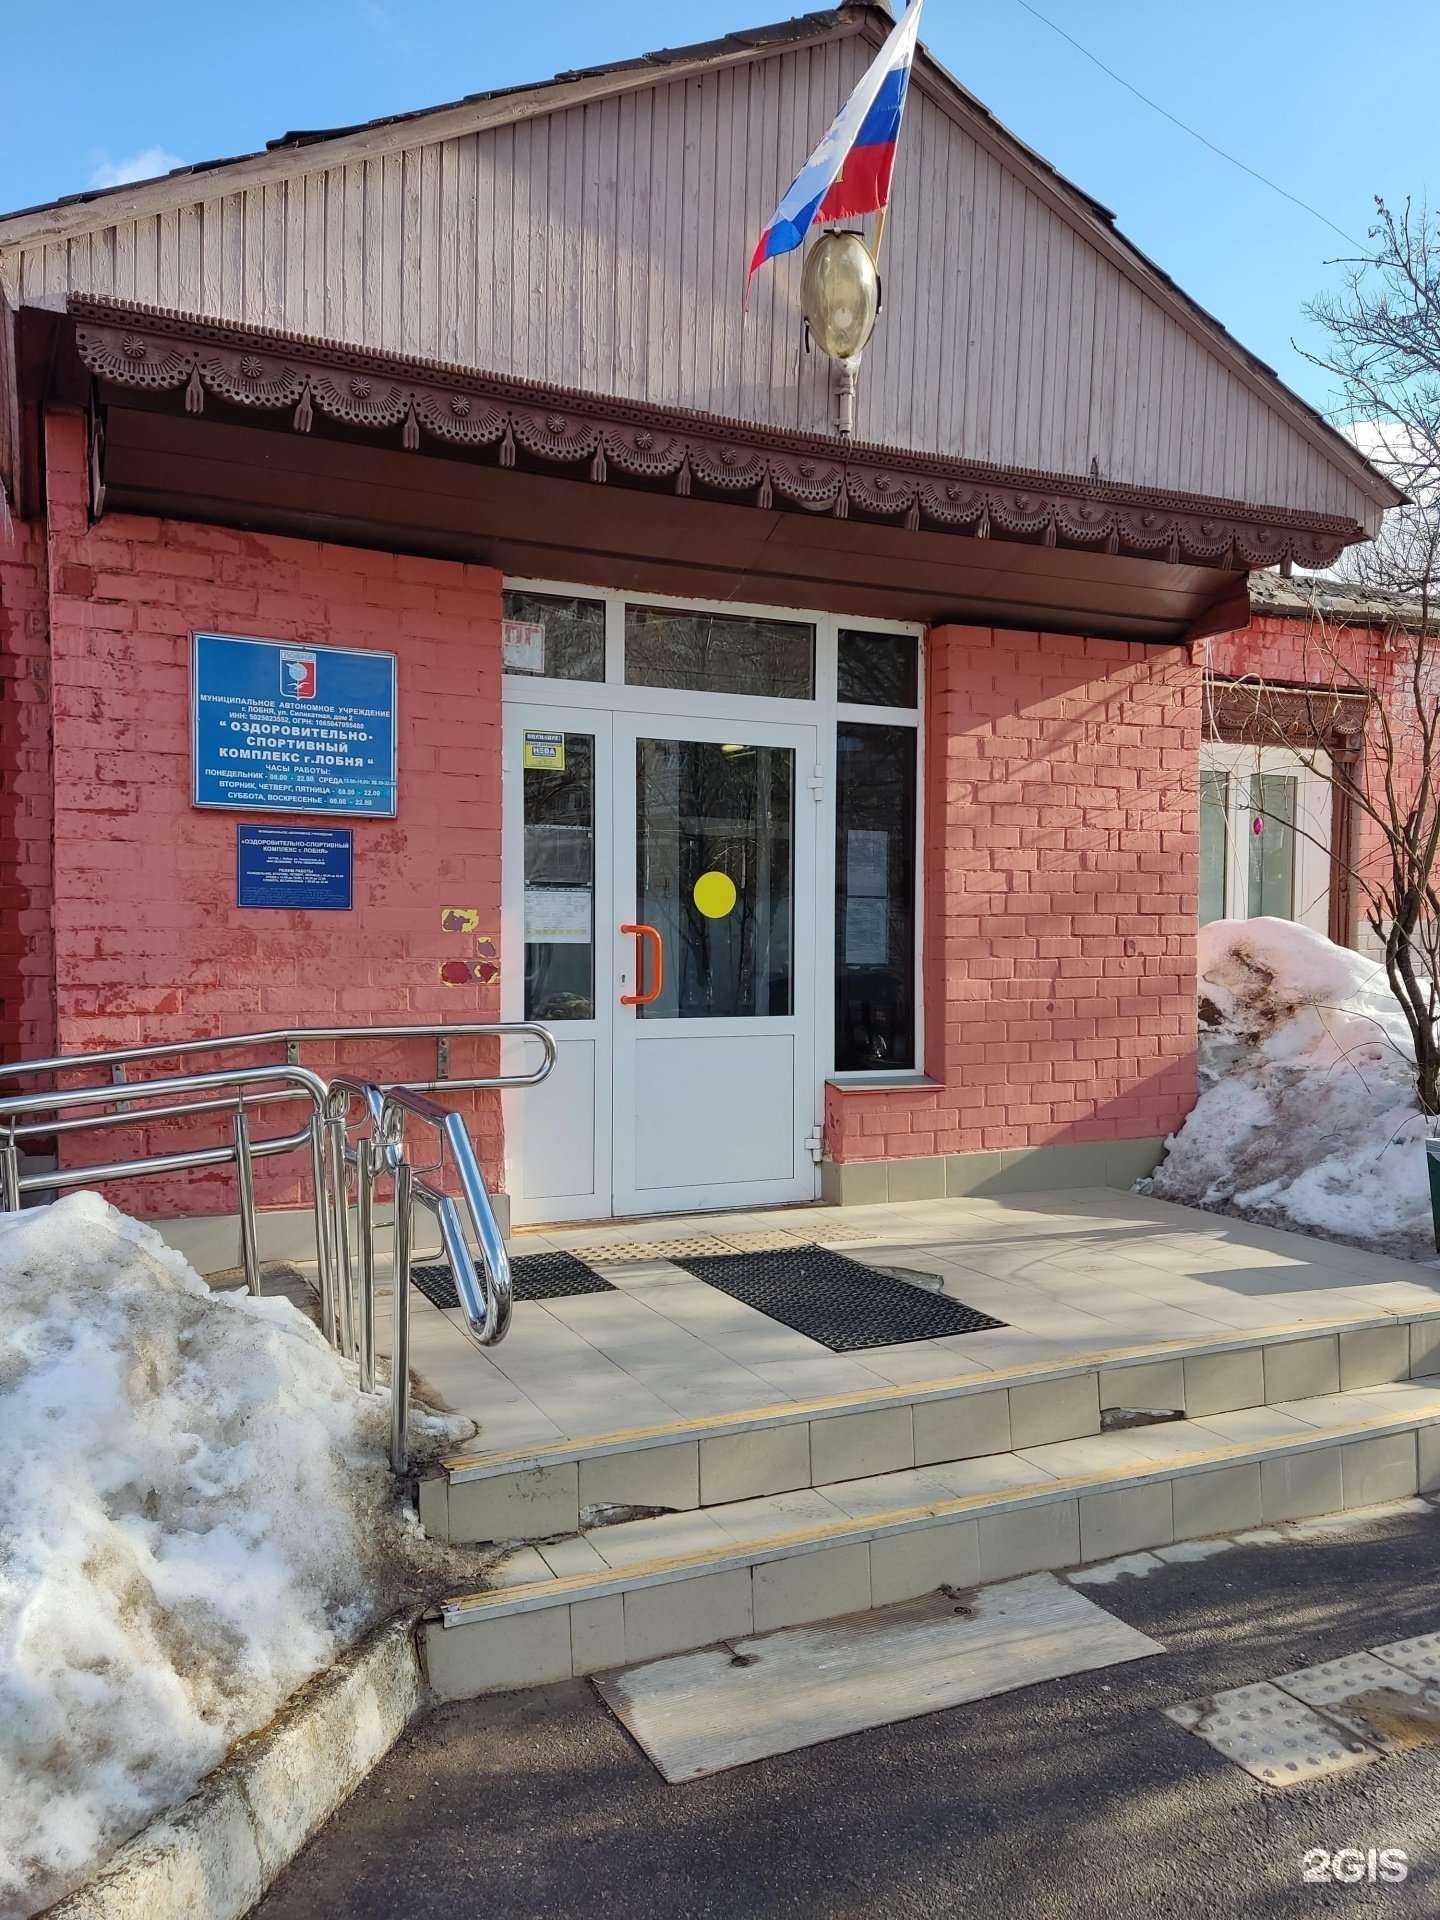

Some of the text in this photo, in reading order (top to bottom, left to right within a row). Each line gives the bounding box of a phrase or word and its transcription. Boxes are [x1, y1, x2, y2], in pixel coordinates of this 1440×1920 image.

[200, 694, 391, 718] МУНИЦИПАЛЬНОЕ АВТОНОМНОЕ УЧРЕЖДЕНИЕ
[246, 736, 348, 753] СПОРТИВНЫЙ
[219, 747, 300, 762] КОМПЛЕКС
[265, 764, 290, 772] ЧАСЫ
[205, 768, 264, 779] ПОНЕДЕЛЬНИК
[318, 776, 344, 785] СРЕДА
[219, 780, 257, 790] ВТОРНИК,
[259, 783, 294, 793] ЧЕТВЕРГ,
[295, 785, 330, 795] ПЯТНИЦА
[227, 791, 266, 801] СУББОТА,
[267, 794, 323, 804] ВОСКРЕСЕНЬЕ
